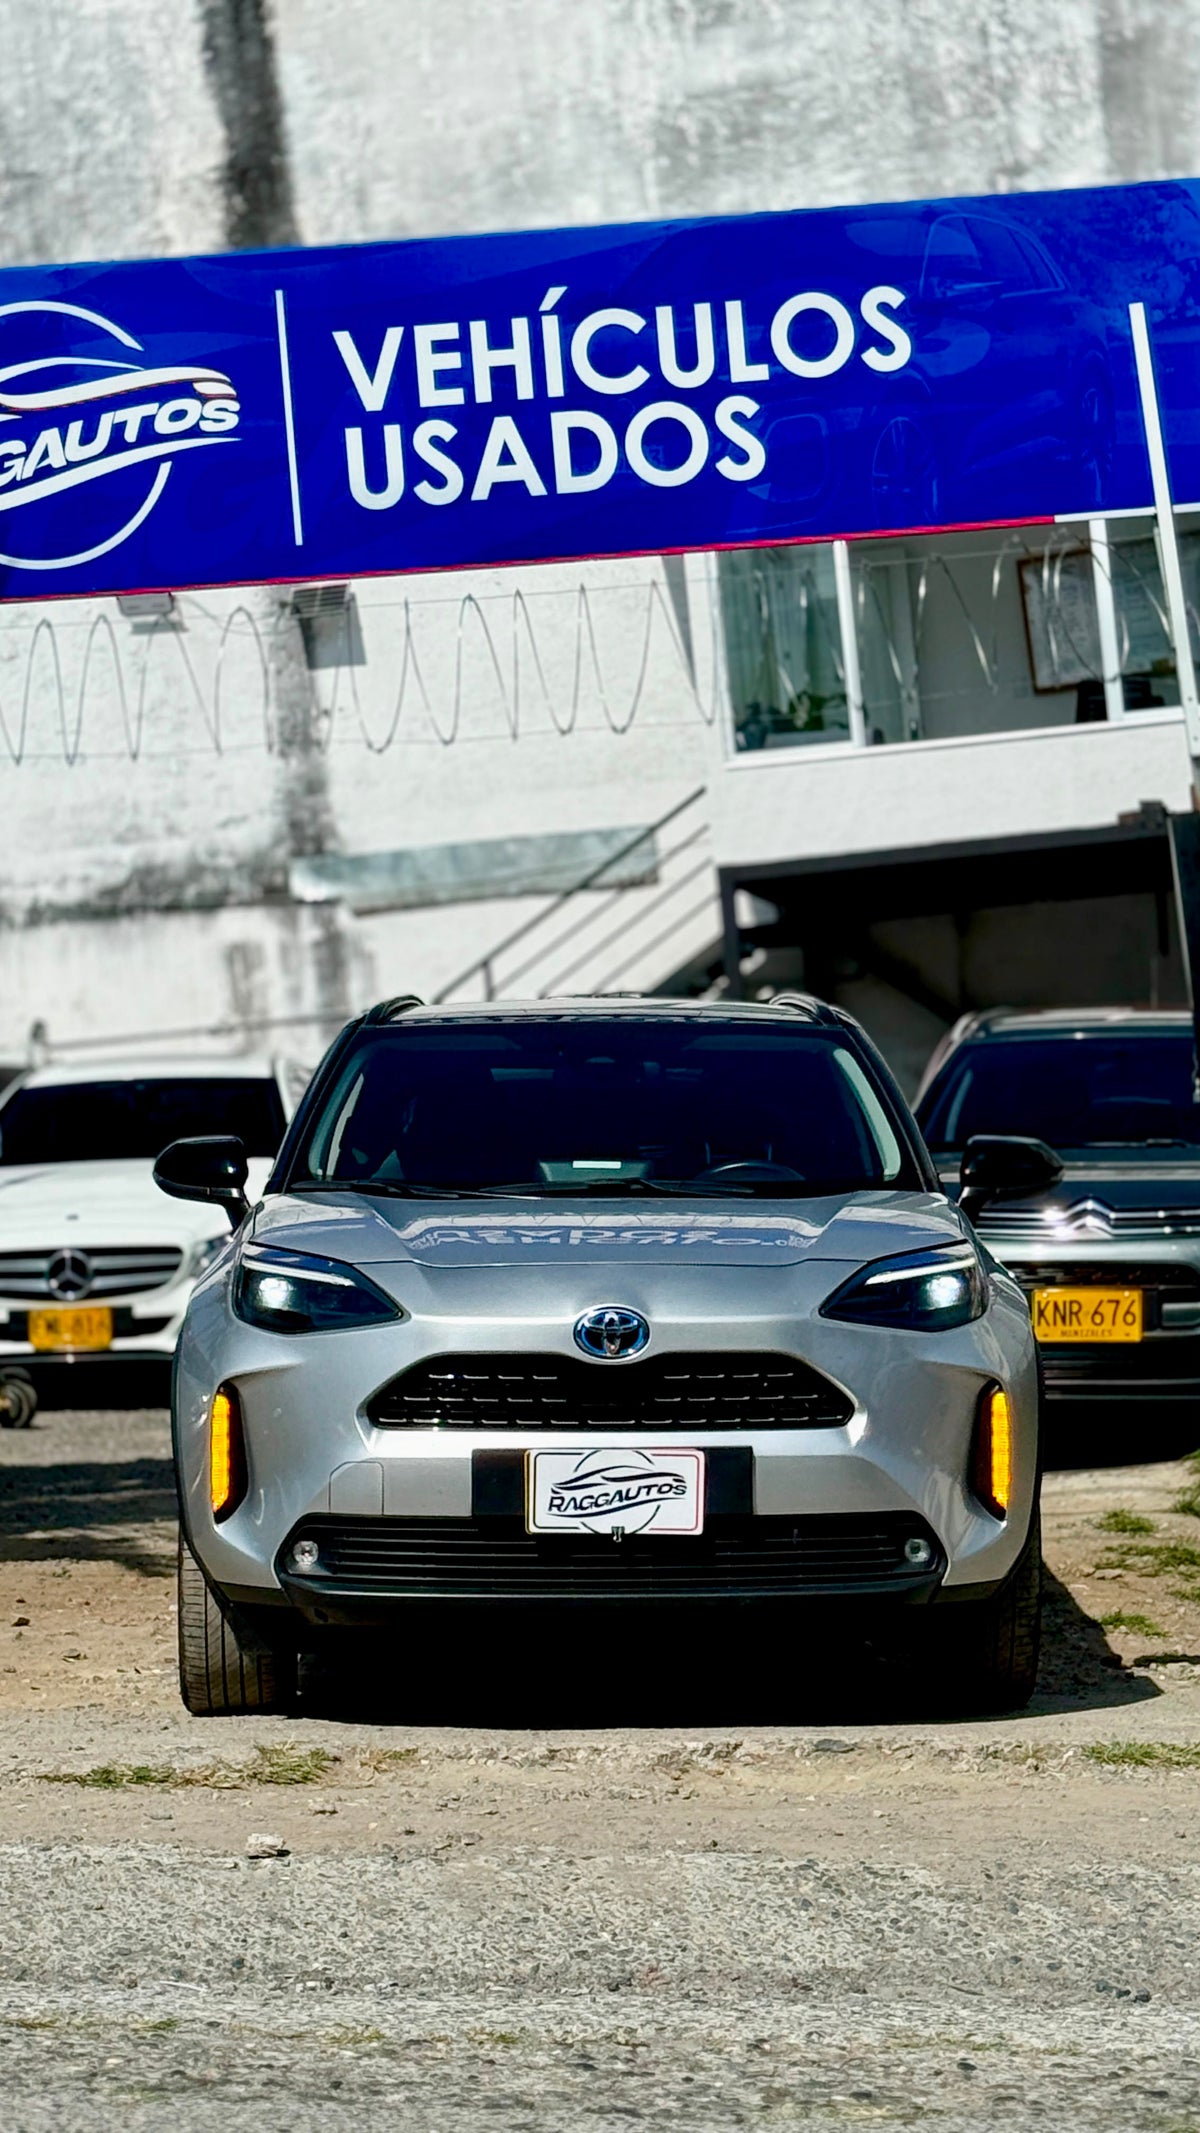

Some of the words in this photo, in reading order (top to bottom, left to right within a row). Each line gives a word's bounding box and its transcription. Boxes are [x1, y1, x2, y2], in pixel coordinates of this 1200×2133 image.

[332, 286, 912, 412] VEHÍCULOS
[344, 396, 766, 510] USADOS
[1036, 1299, 1082, 1327] KNR
[1090, 1299, 1137, 1327] 676
[547, 1482, 688, 1513] RAGGAUTOS
